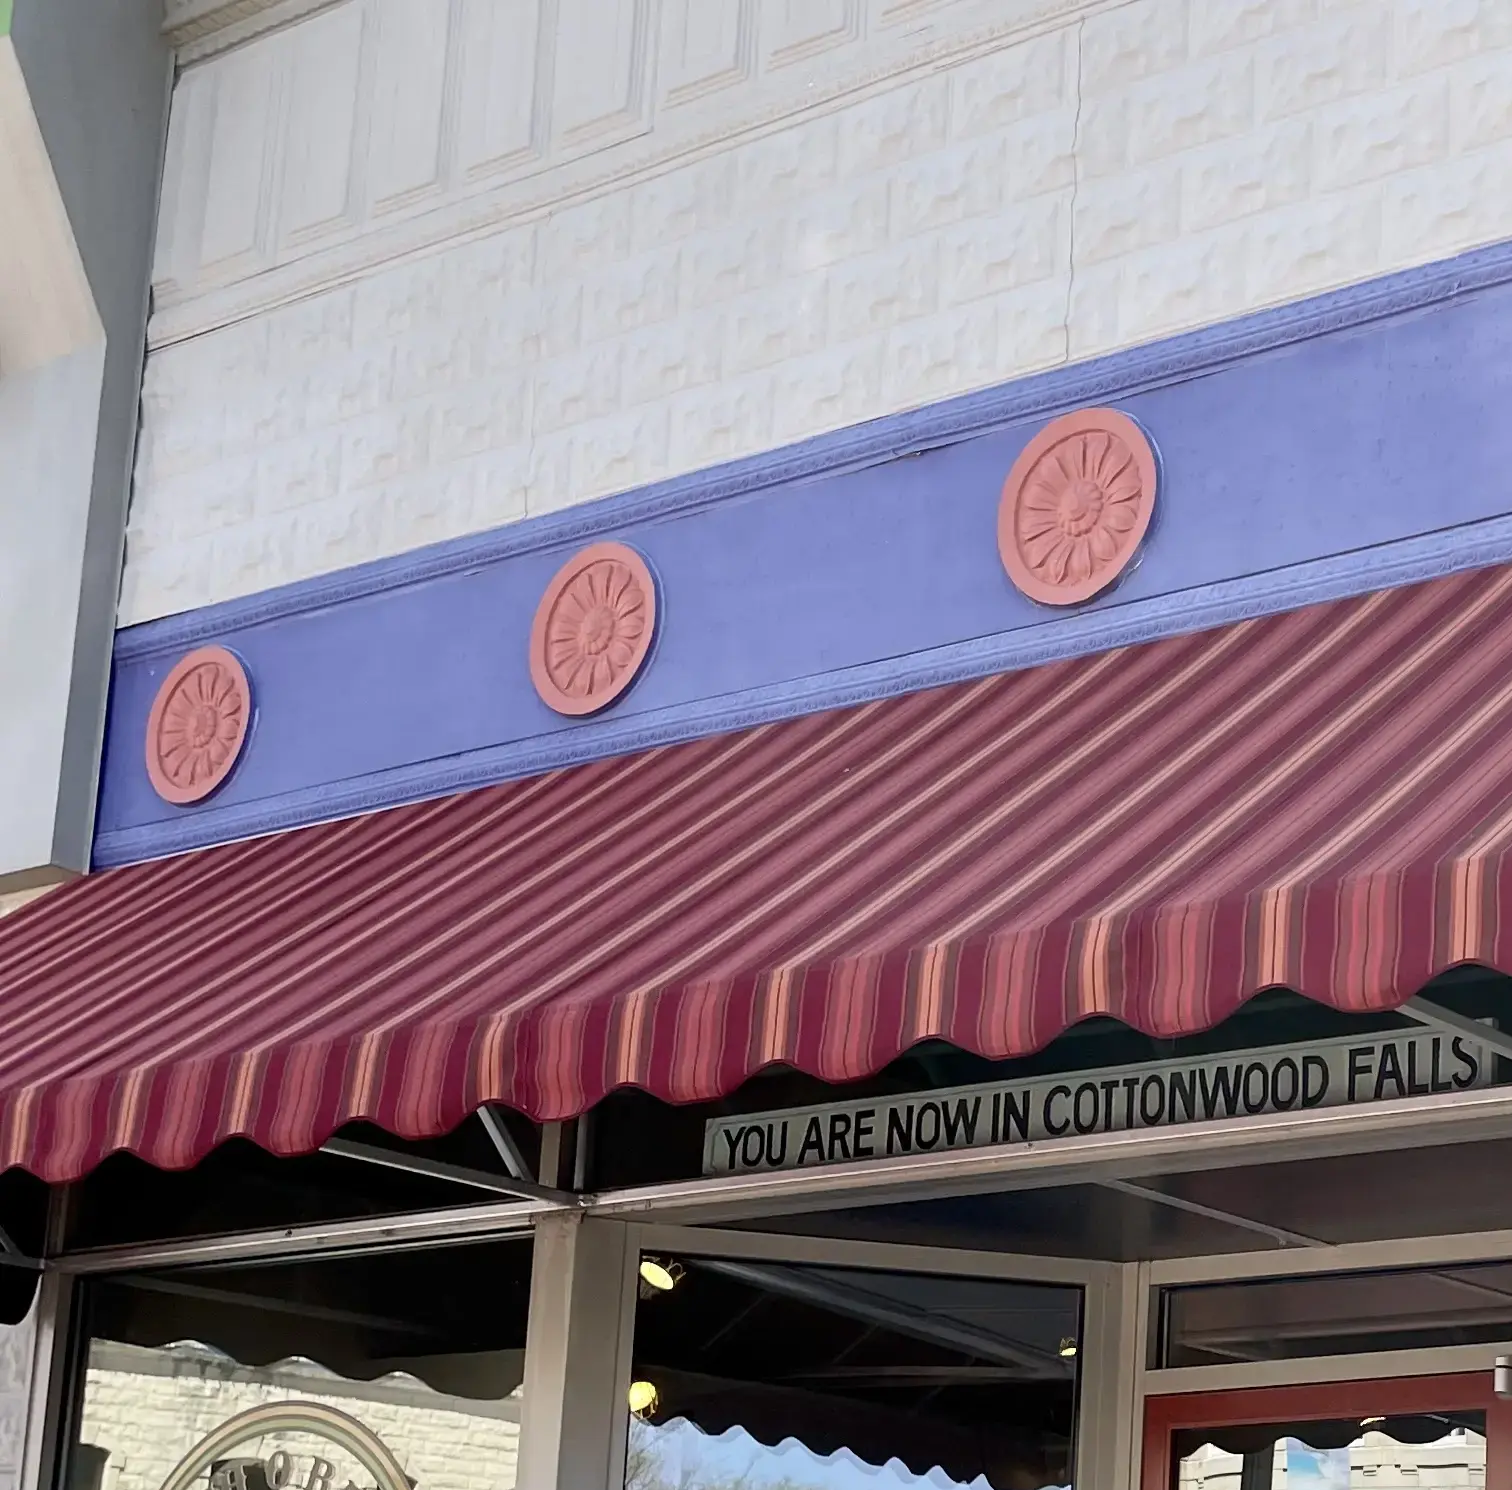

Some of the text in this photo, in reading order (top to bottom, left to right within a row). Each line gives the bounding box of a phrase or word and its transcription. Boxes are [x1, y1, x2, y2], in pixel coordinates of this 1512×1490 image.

[723, 1036, 1480, 1170] YOU ARE NOW IN COTTONWOOD FALLS
[263, 1449, 297, 1490] O
